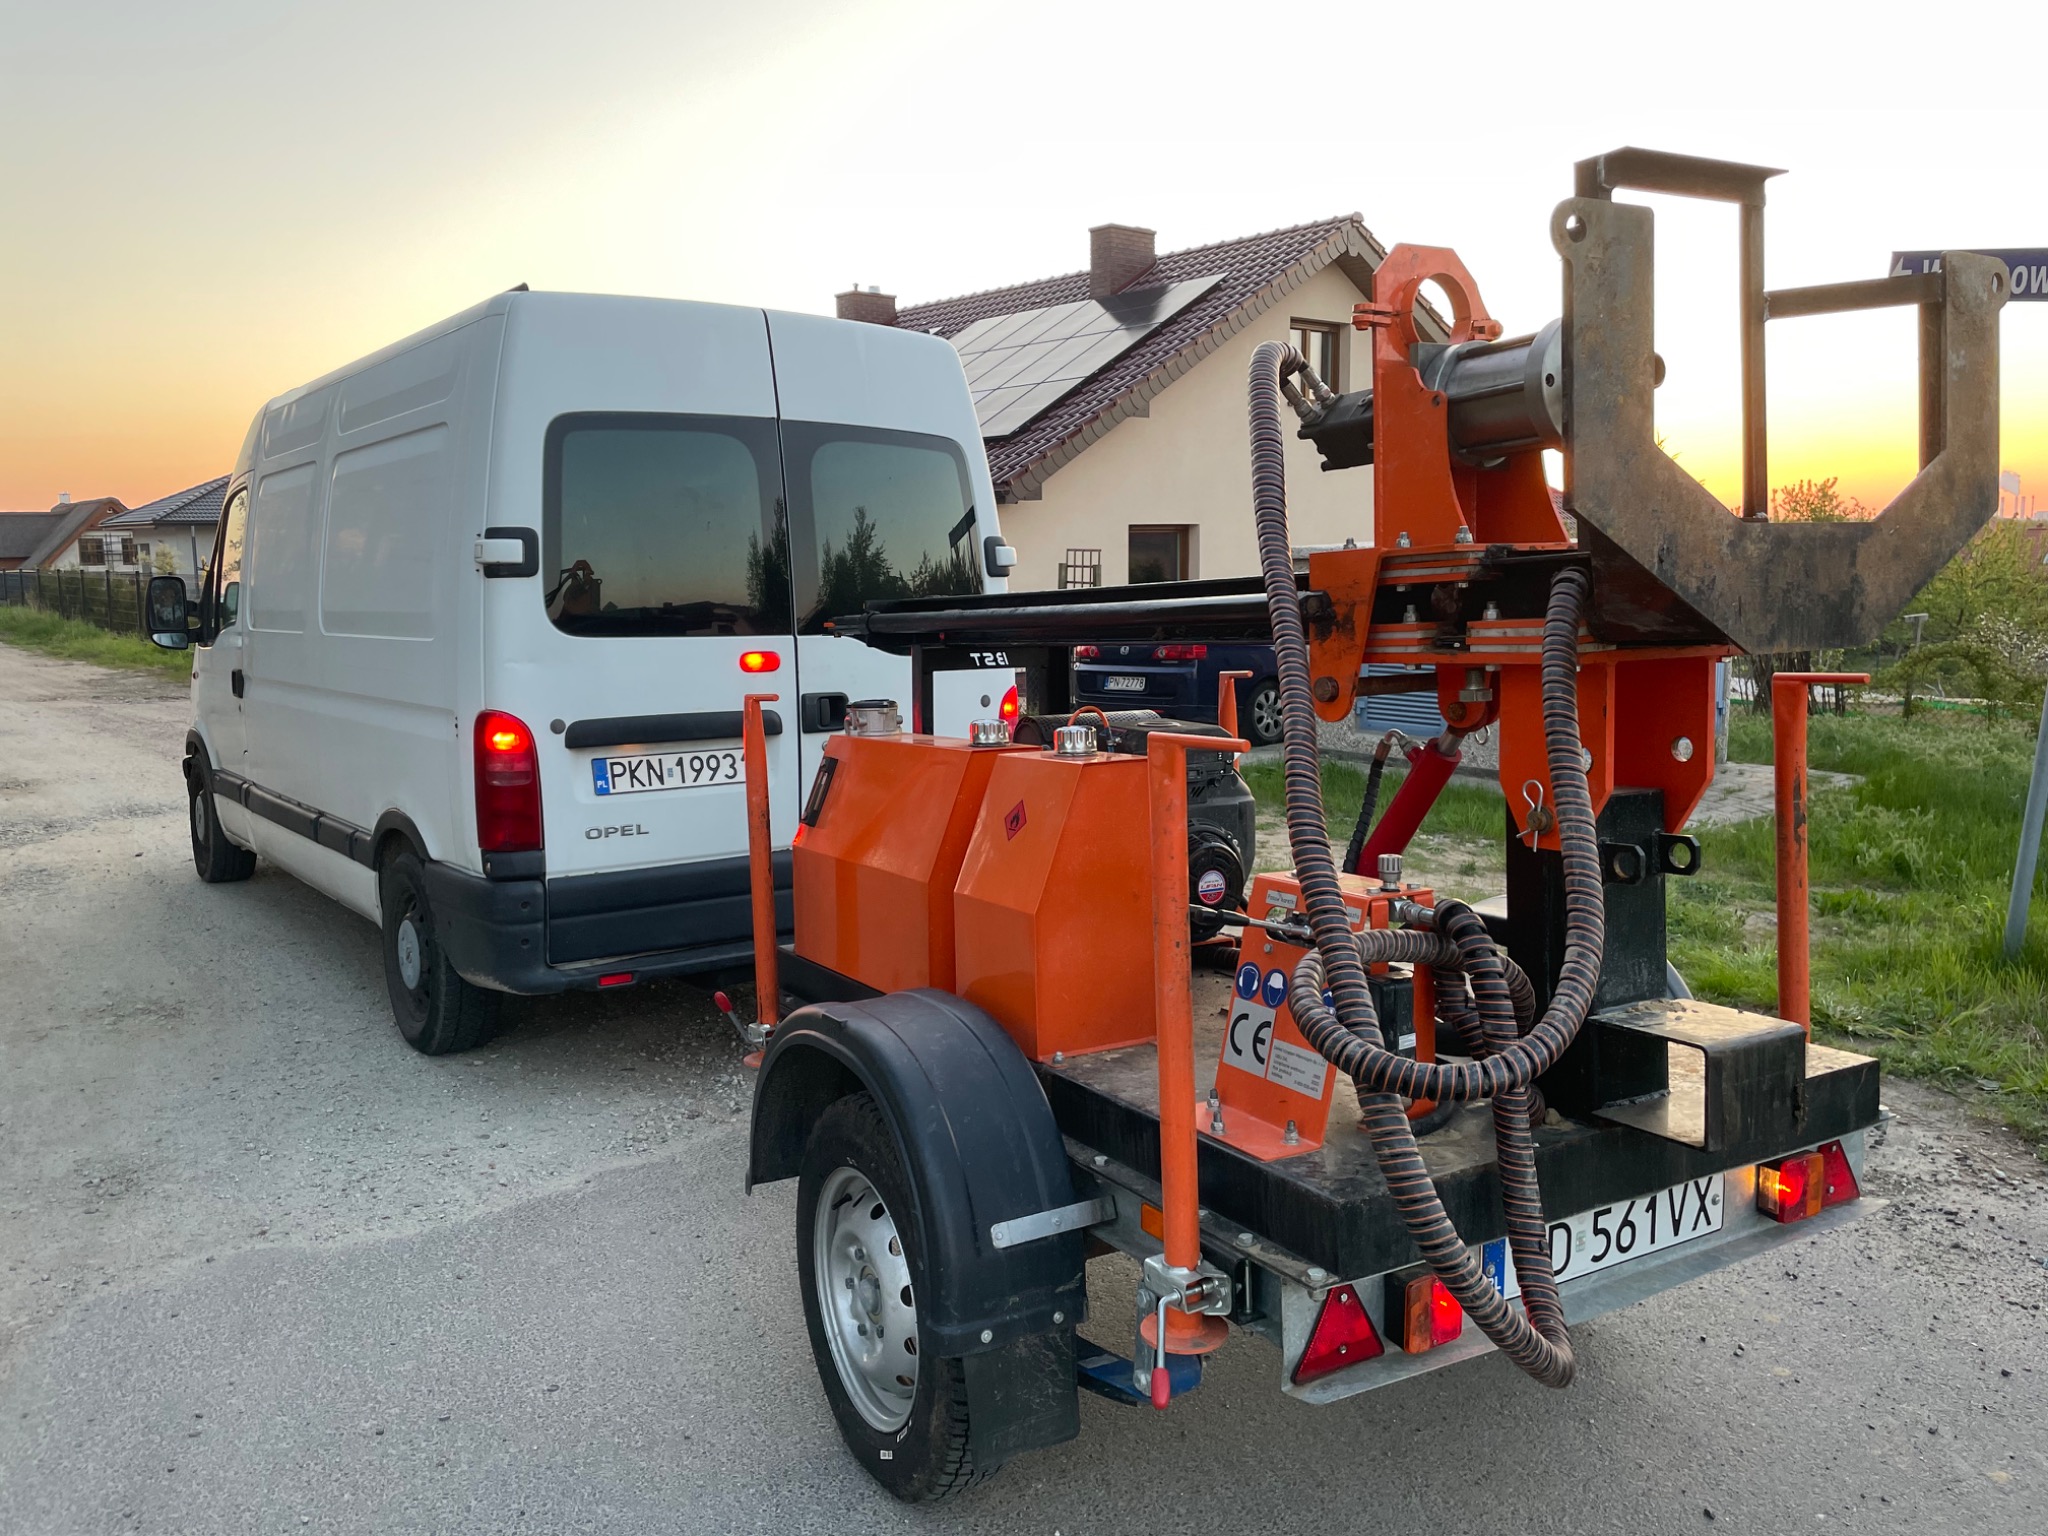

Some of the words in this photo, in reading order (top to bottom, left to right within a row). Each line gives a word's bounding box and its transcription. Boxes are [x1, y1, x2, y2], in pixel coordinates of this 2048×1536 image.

[1121, 677, 1144, 688] 72778
[609, 758, 665, 790] PKN
[675, 753, 746, 784] 1993
[597, 780, 608, 789] PL
[585, 824, 650, 840] OPEL
[1550, 1221, 1572, 1277] D
[1590, 1176, 1712, 1263] 561VX
